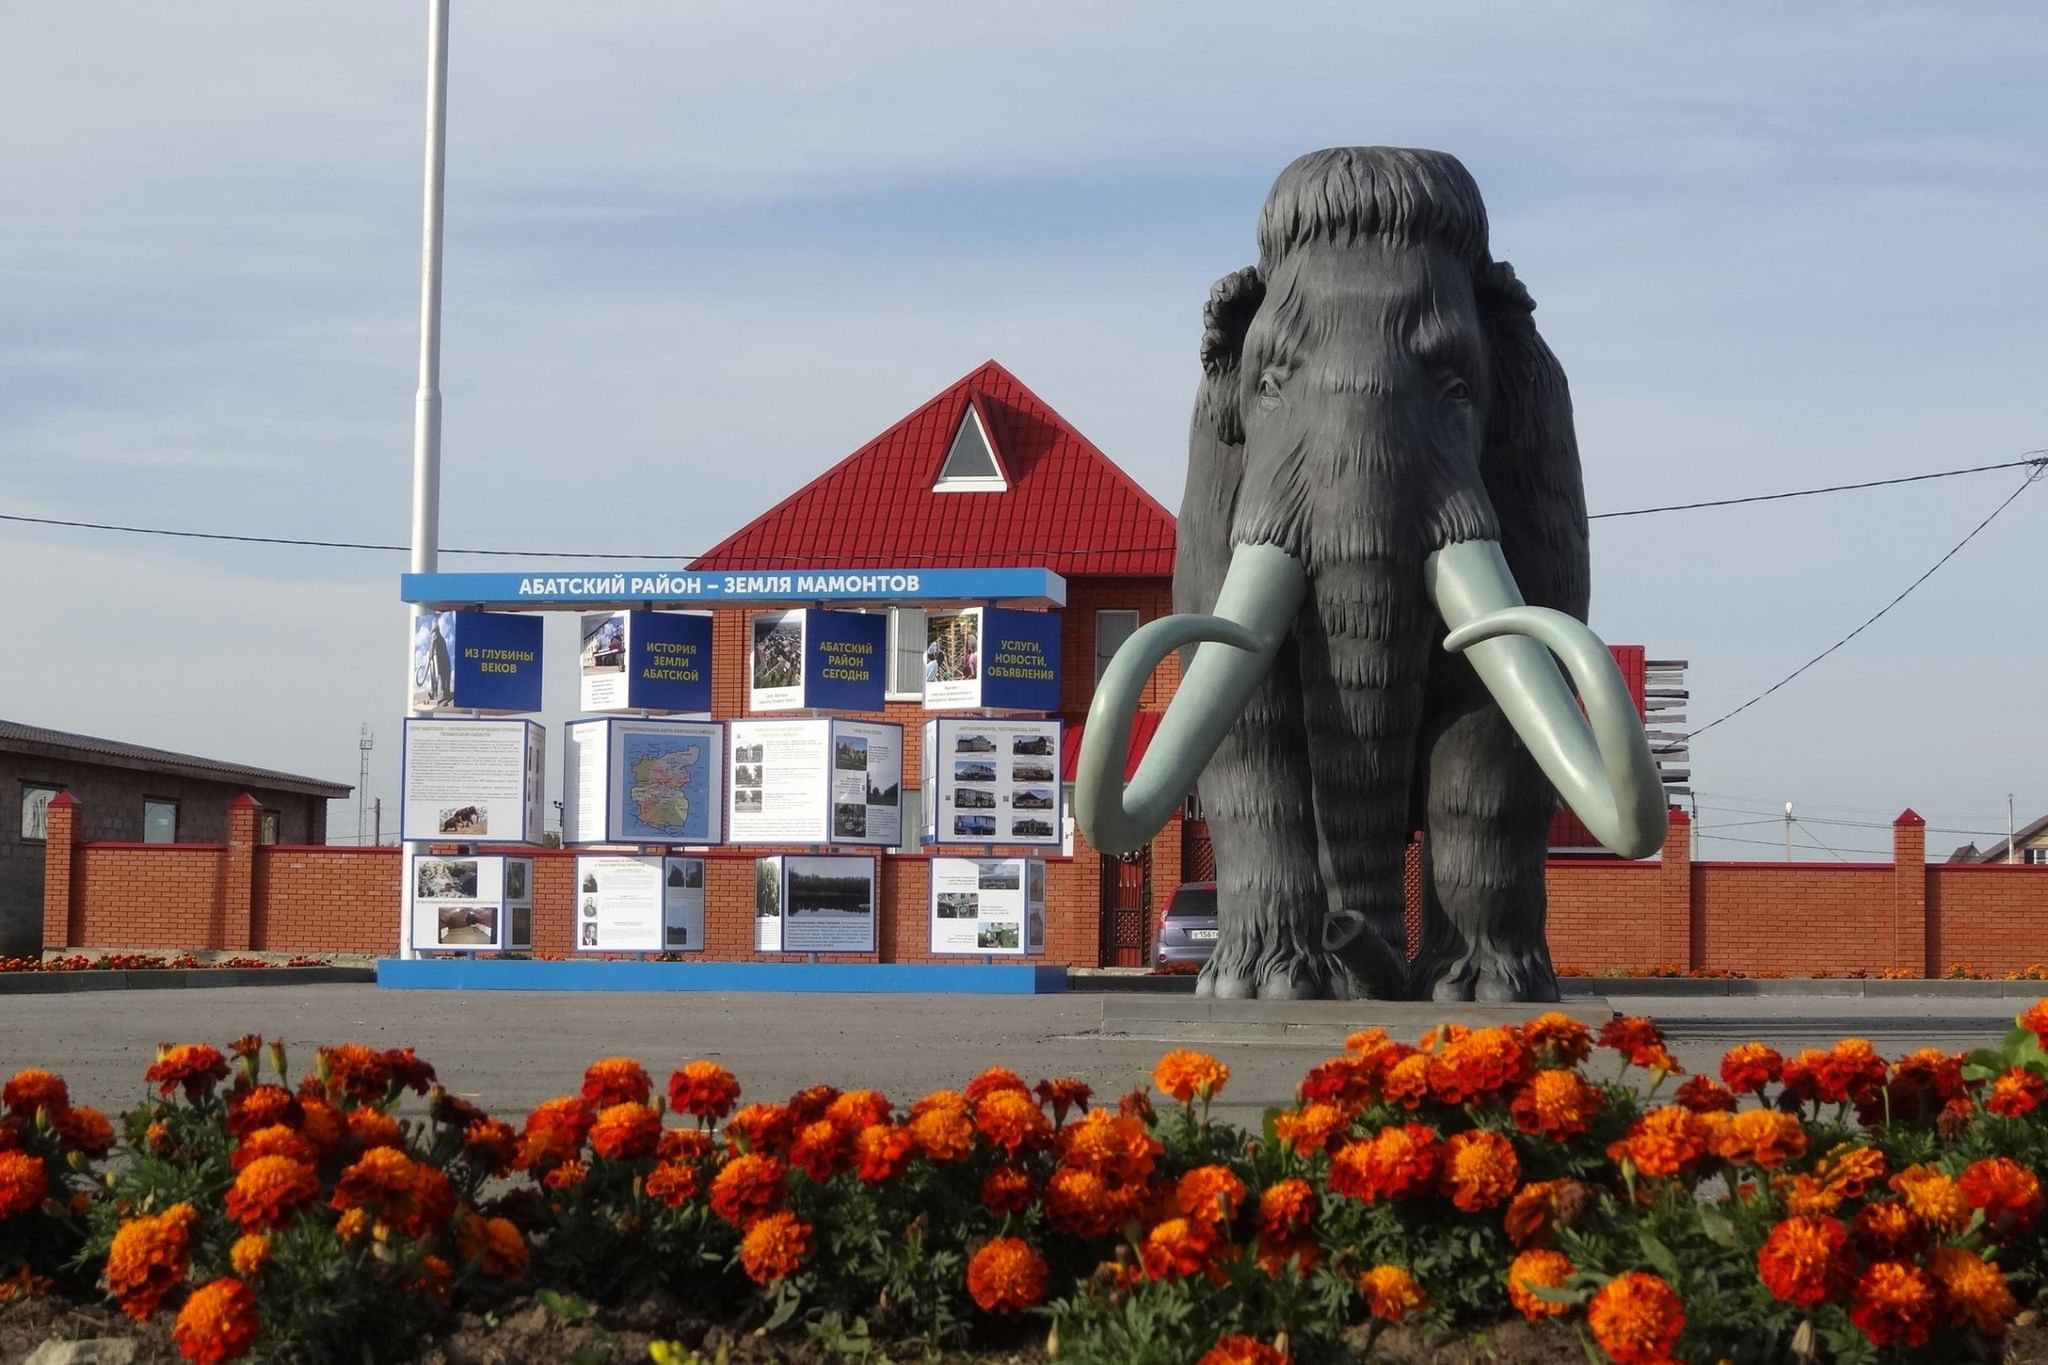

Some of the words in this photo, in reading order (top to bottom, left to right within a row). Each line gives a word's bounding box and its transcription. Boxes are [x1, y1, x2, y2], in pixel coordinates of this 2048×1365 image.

[518, 574, 626, 595] АБАТСКИЙ
[631, 573, 701, 594] РАЙОН
[724, 576, 792, 594] ЗЕМЛЯ
[797, 575, 920, 593] МАМОНТОВ
[646, 642, 697, 655] ИСТОРИЯ
[819, 641, 873, 654] АБАТСКИЙ
[1000, 639, 1042, 654] УСЛУГИ,
[464, 648, 480, 659] ИЗ
[481, 648, 534, 662] ГЛУБИНЫ
[828, 654, 864, 667] РАЙОН
[995, 653, 1047, 668] НОВОСТИ,
[481, 662, 518, 674] ВЕКОВ
[653, 656, 689, 668] ЗЕМЛИ
[642, 668, 699, 682] АБАТСКОЙ
[822, 668, 869, 681] СЕГОДНЯ
[987, 666, 1054, 681] ОБЪЯВЛЕНИЯ
